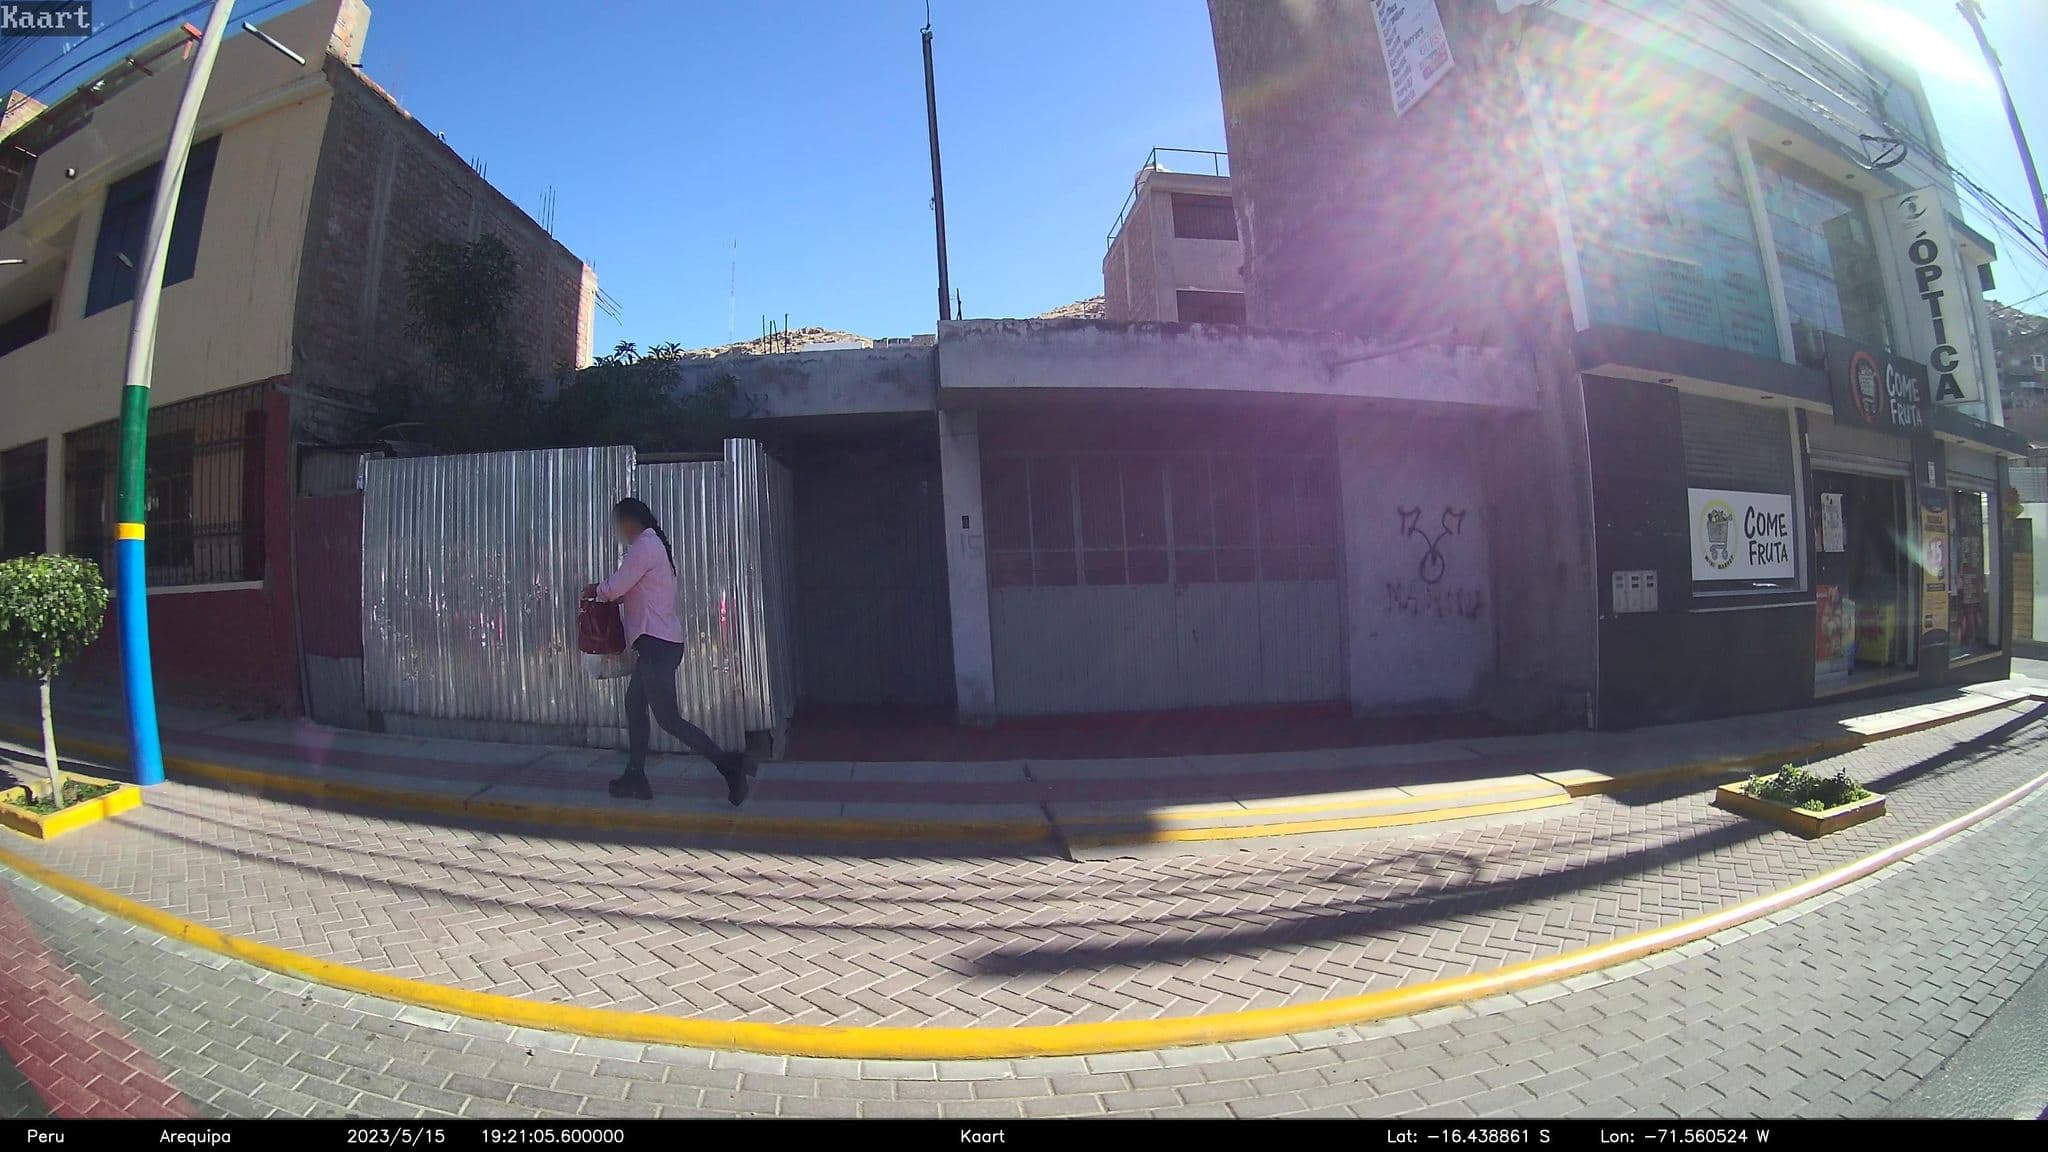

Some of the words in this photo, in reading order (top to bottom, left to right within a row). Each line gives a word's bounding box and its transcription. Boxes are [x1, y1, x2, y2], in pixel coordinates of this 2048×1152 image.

[1908, 230, 1965, 400] ÓPTICA
[1886, 362, 1921, 402] COME
[1890, 397, 1924, 427] FRUTA
[1744, 505, 1788, 539] COME
[1749, 540, 1788, 566] FRUTA
